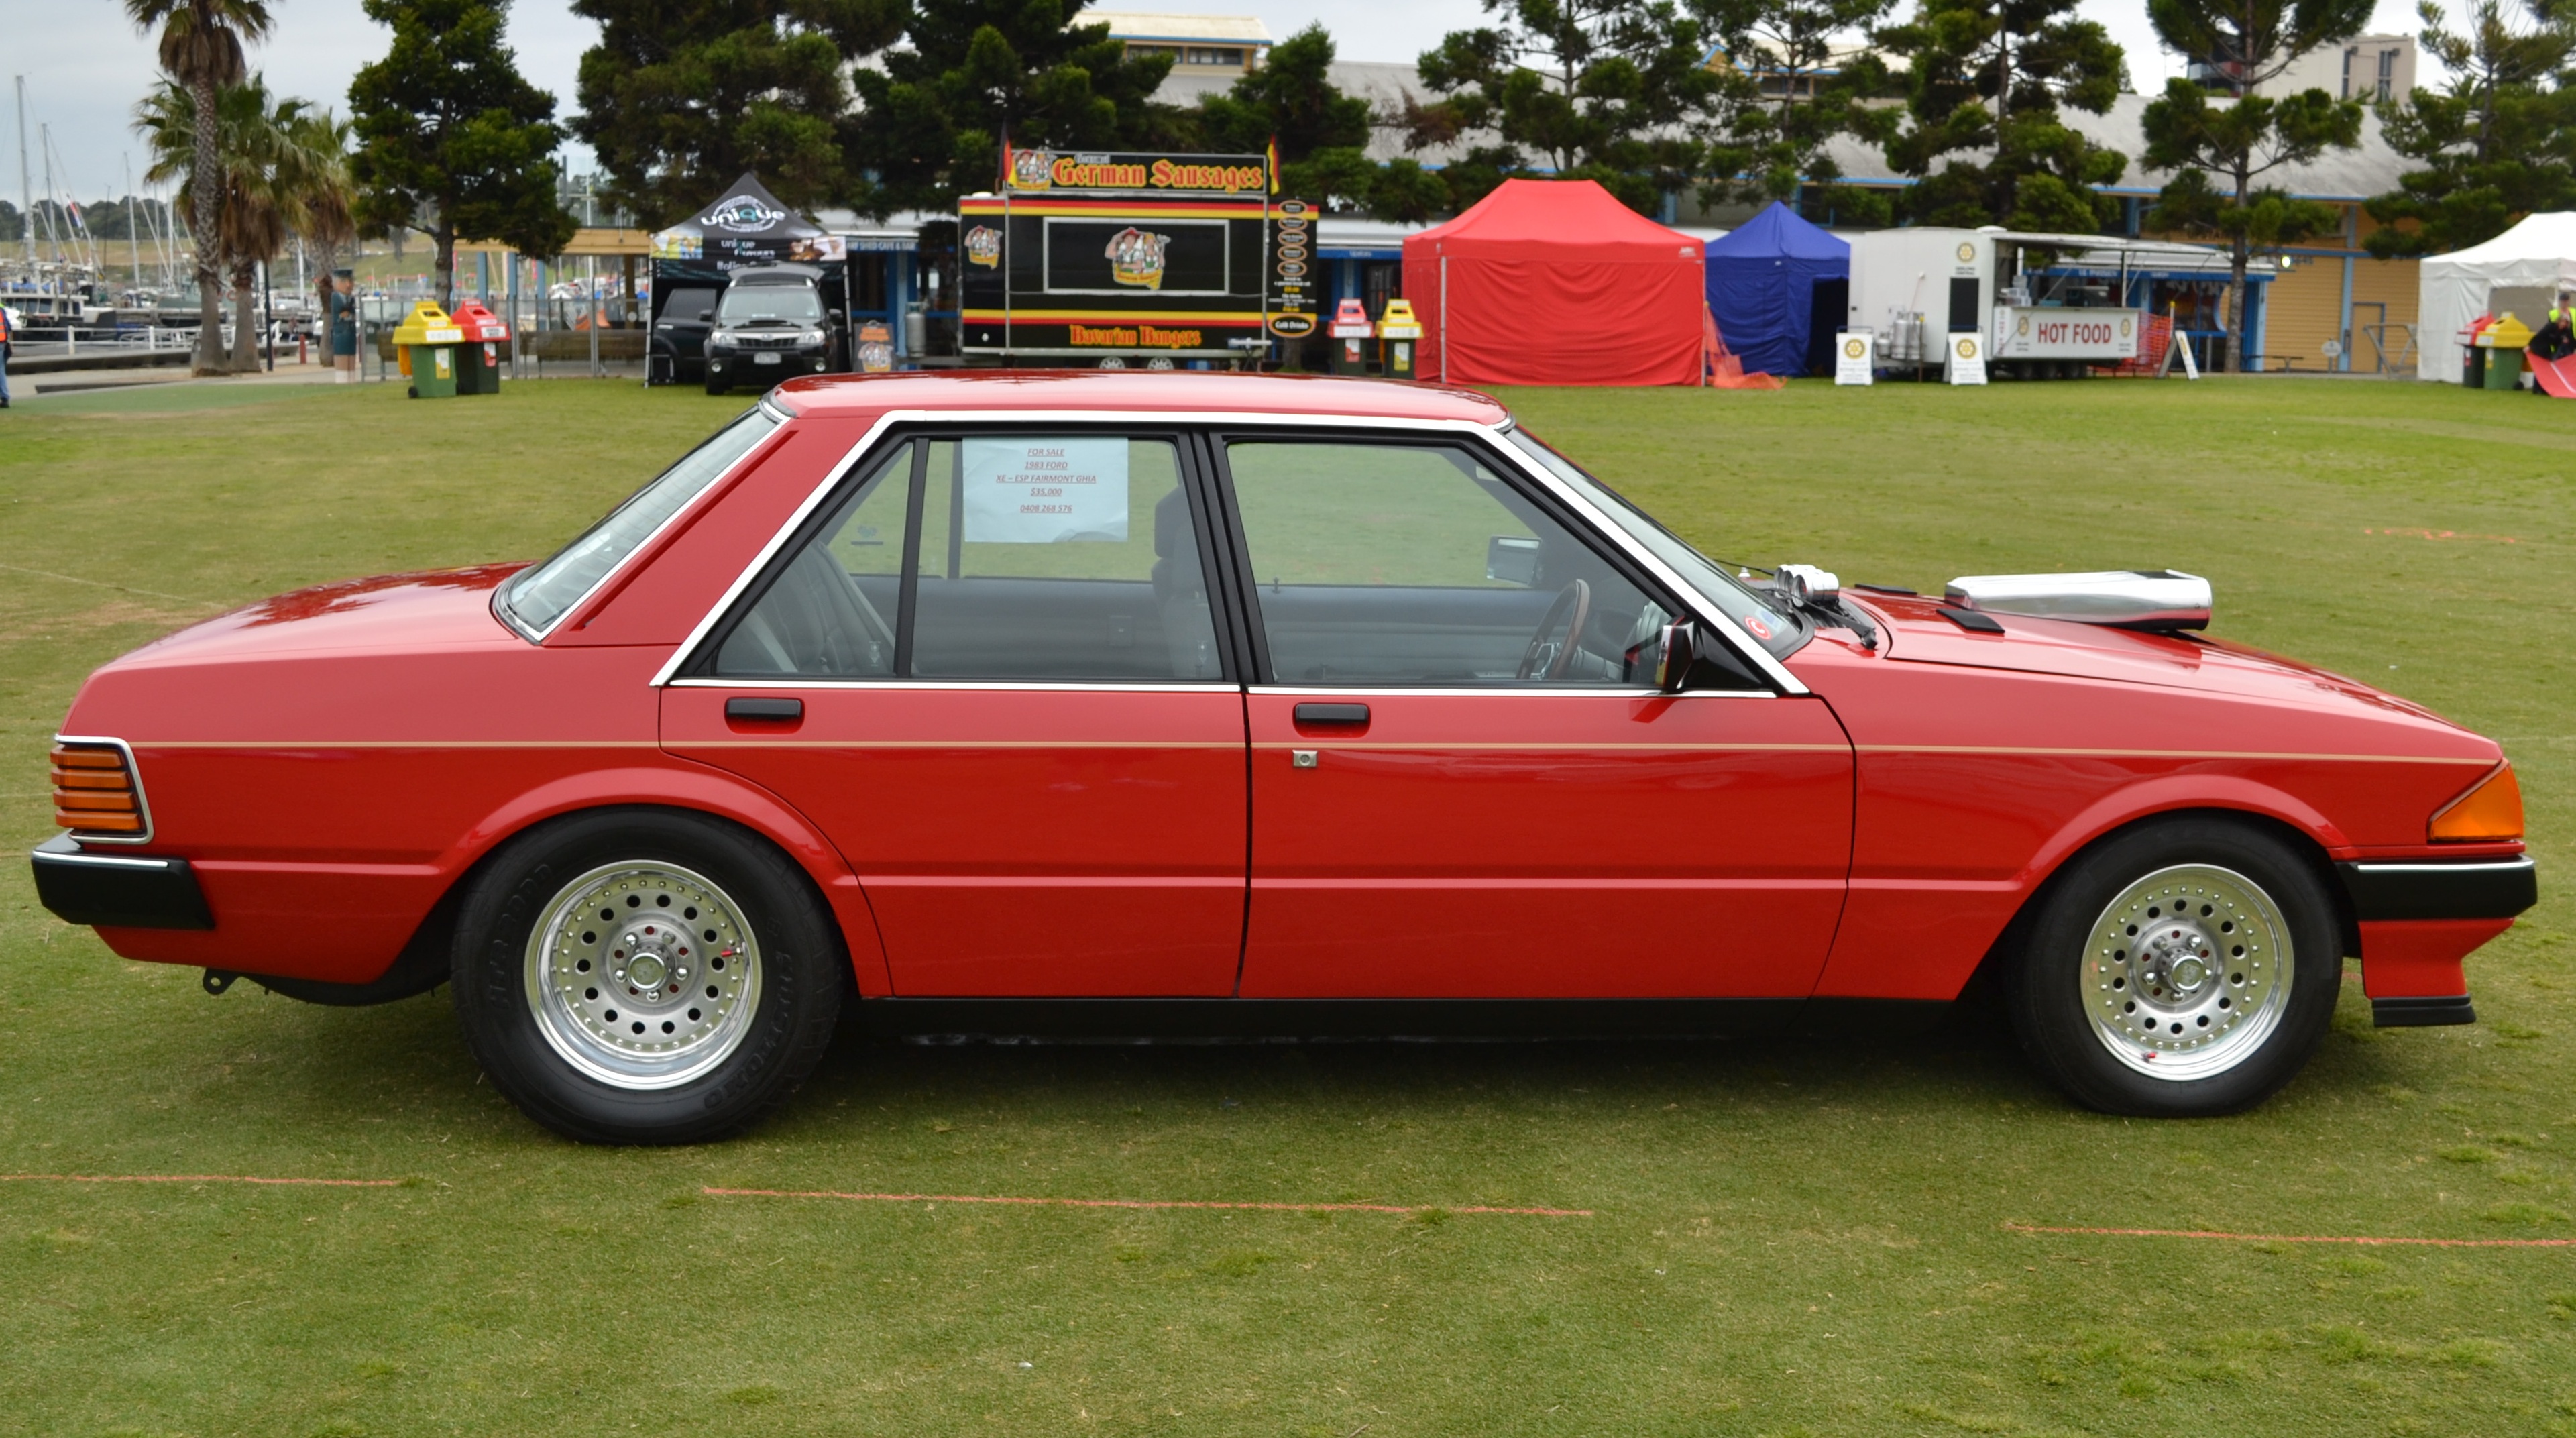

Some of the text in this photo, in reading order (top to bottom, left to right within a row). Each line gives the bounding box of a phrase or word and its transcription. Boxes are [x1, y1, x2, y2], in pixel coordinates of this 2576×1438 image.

[1052, 157, 1264, 193] German Sausages
[701, 208, 785, 226] unique
[1069, 324, 1202, 349] Bavarian Bangers
[2037, 322, 2112, 344] HOT FOOD
[1027, 449, 1065, 457] FOR SALE
[1025, 461, 1068, 470] 1983 FORD
[996, 475, 1006, 484] XE
[1015, 475, 1029, 484] ESP
[1031, 475, 1074, 484] FAIRMONT
[1076, 475, 1097, 484] GHIA
